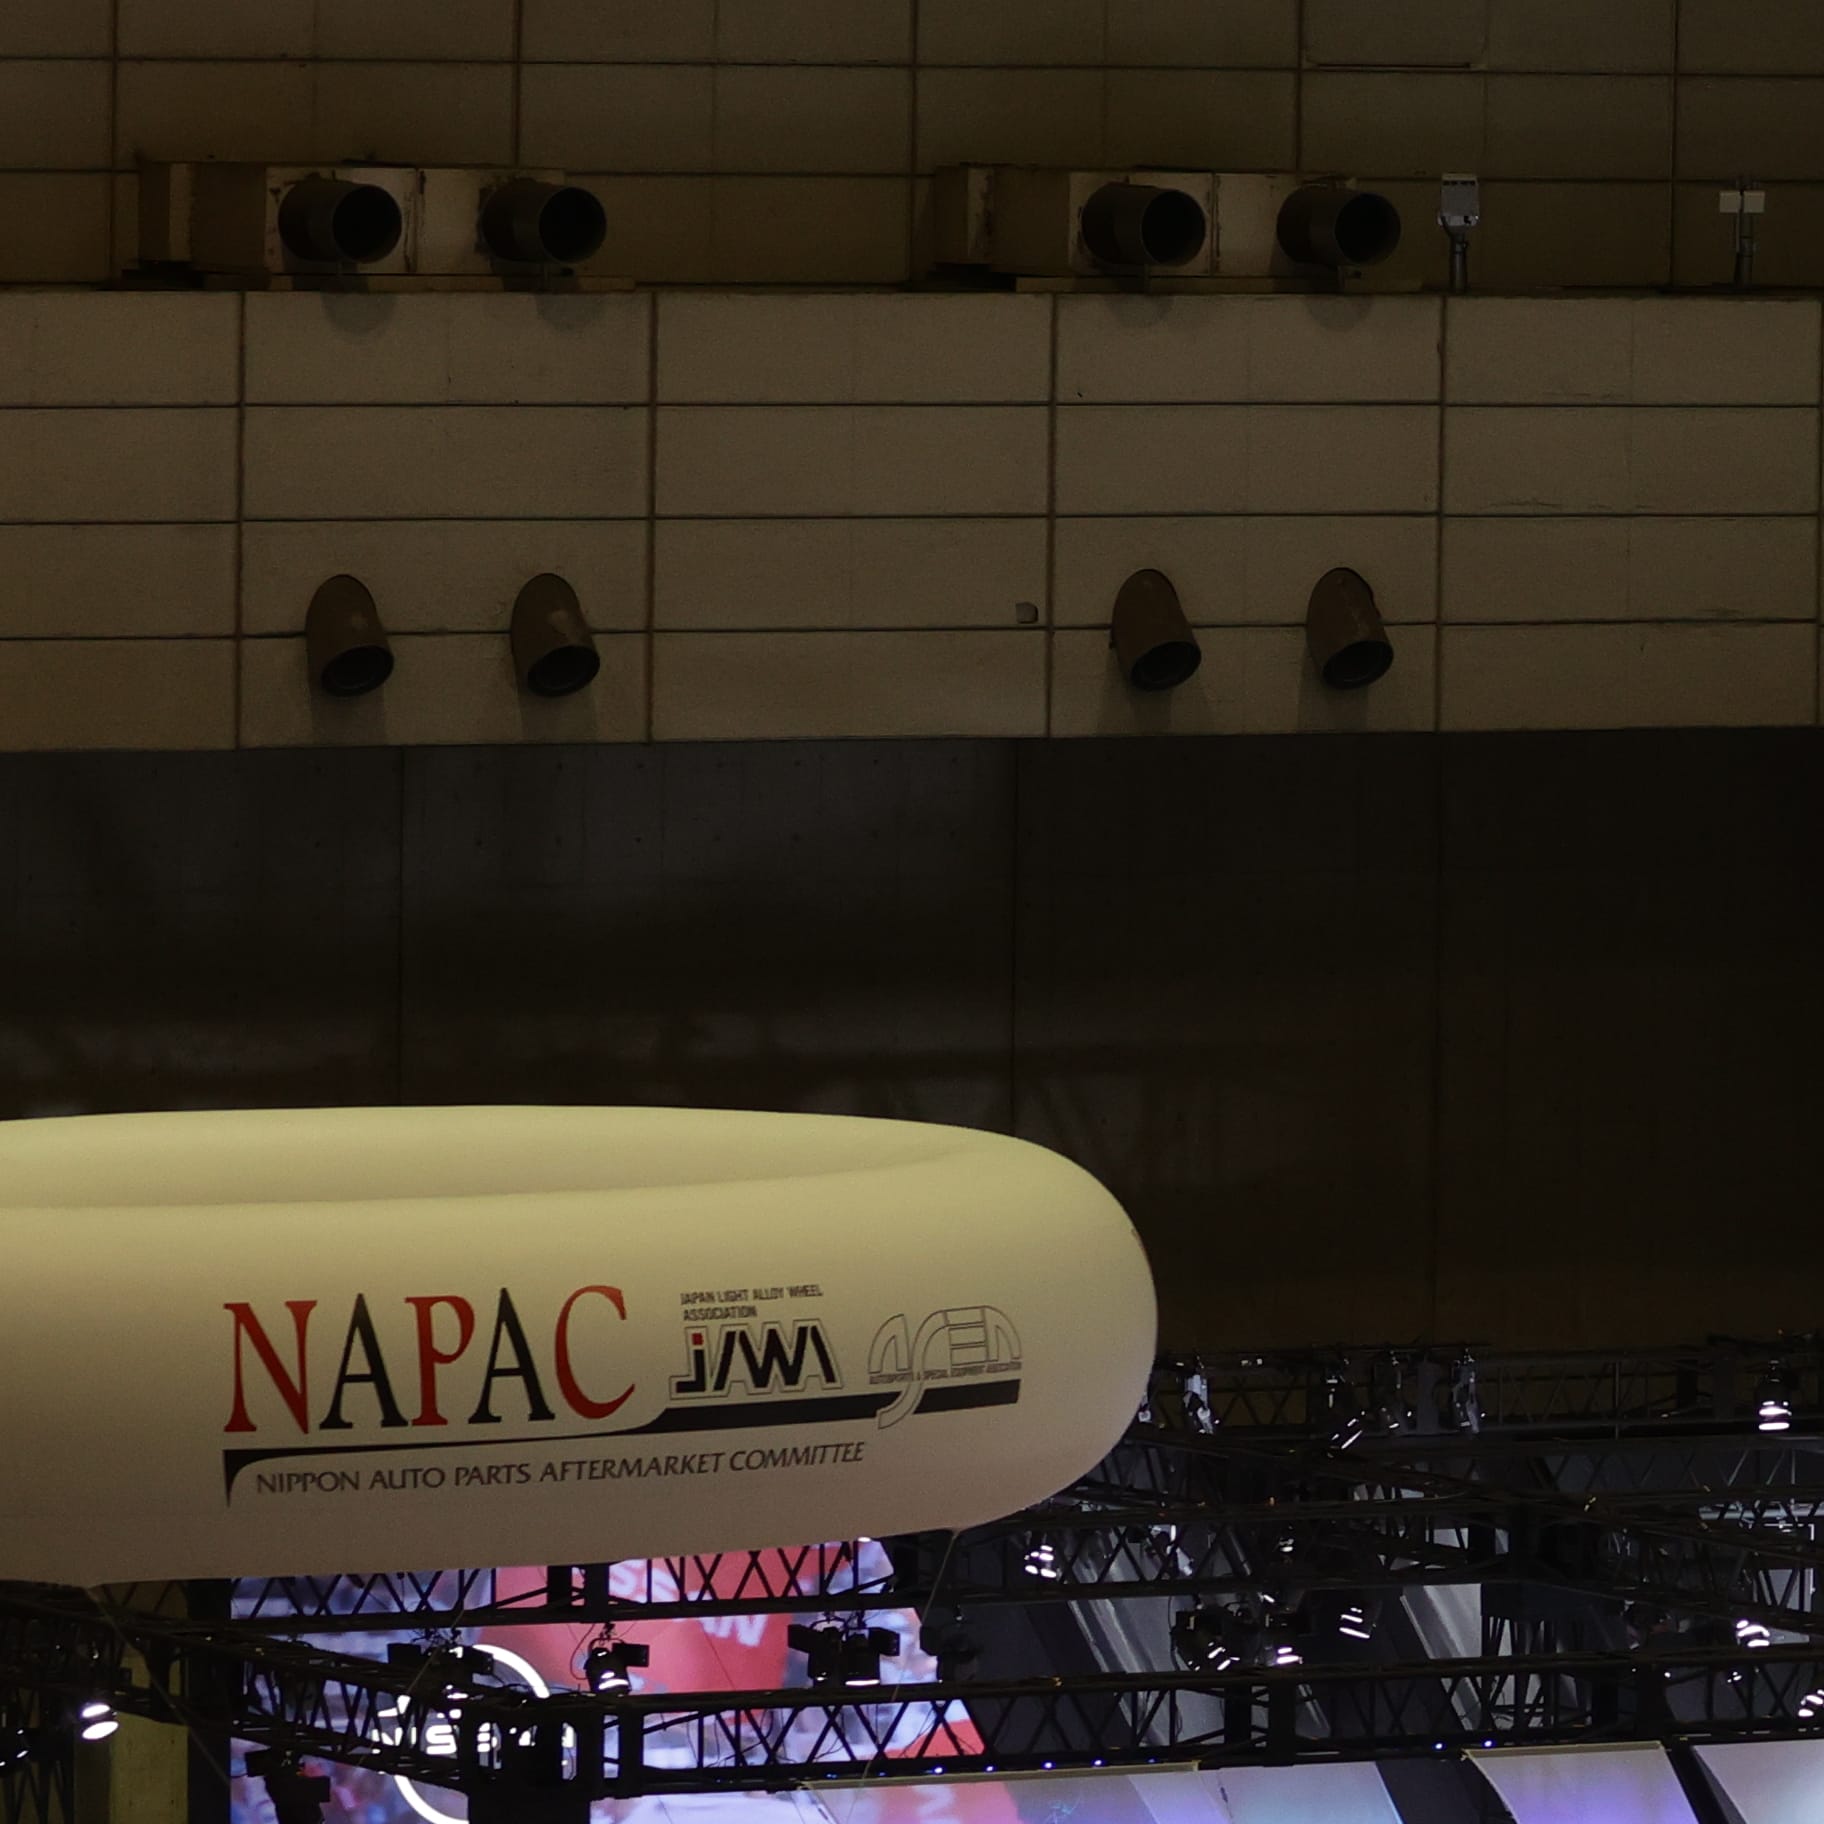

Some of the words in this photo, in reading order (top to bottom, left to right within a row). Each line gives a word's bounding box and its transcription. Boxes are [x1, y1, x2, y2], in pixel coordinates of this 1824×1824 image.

[716, 1289, 750, 1304] LIGHT
[753, 1286, 785, 1302] ALLOY
[786, 1284, 824, 1299] WHEEL
[683, 1304, 758, 1322] ASSOCIATION
[223, 1286, 636, 1434] NAPAC
[256, 1469, 360, 1494] NIPPON
[368, 1466, 446, 1490] AUTO
[453, 1462, 532, 1486] PARTS
[539, 1452, 725, 1482] AFTERMARKET
[728, 1441, 866, 1472] COMMITTEE
